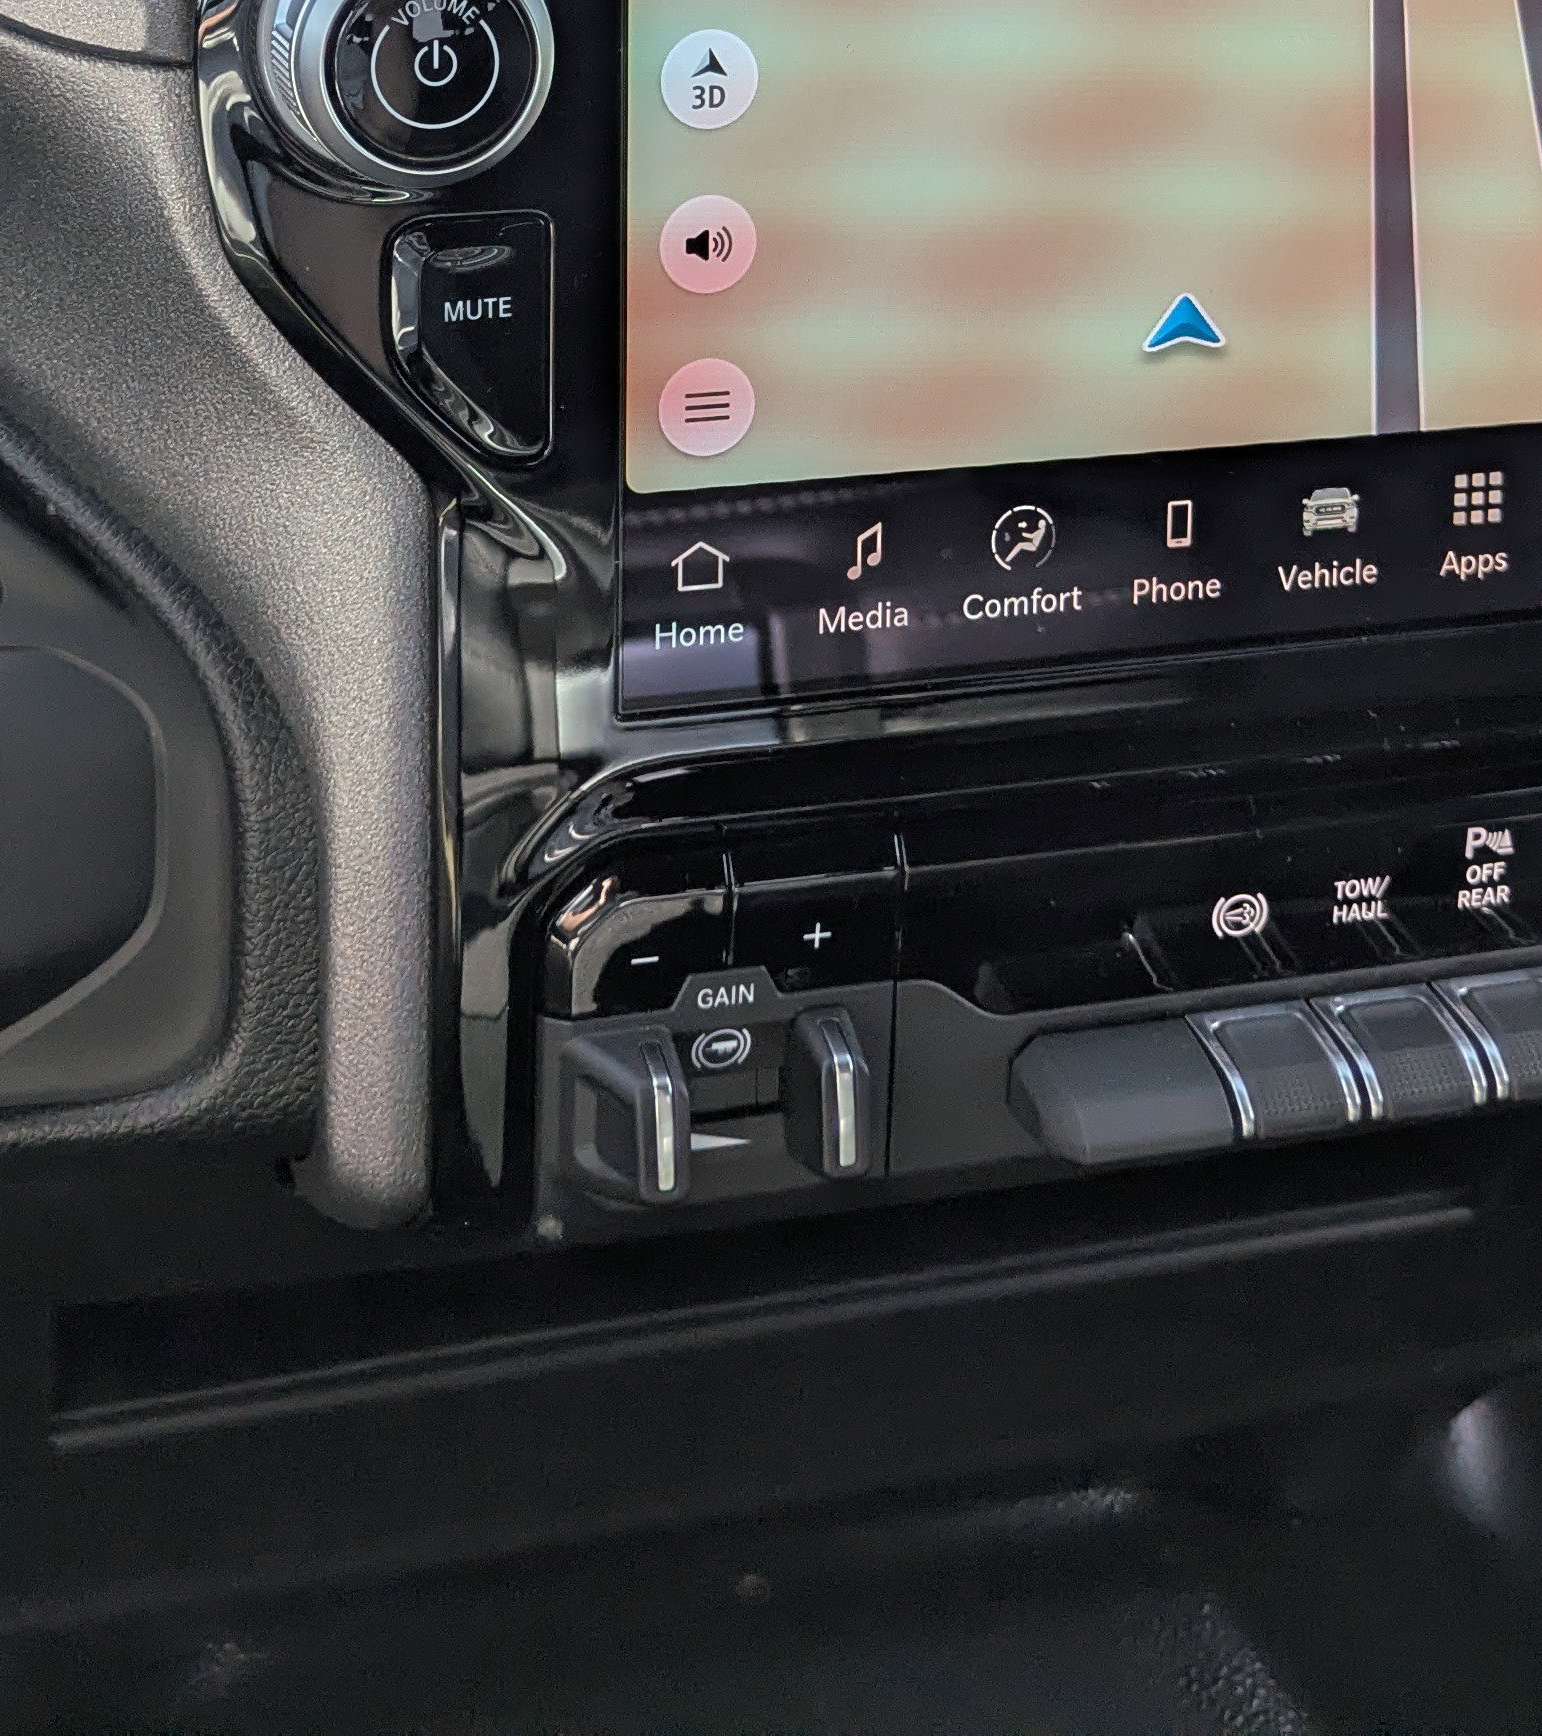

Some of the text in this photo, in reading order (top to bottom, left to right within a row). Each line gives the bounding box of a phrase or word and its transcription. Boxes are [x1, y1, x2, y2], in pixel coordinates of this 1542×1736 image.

[691, 85, 726, 110] 3D
[444, 296, 512, 323] MUTE
[654, 619, 745, 650] Home
[817, 600, 909, 635] Media
[962, 584, 1083, 622] Comfort
[1132, 574, 1222, 606] Phone
[1278, 559, 1378, 593] Vehicle
[1439, 547, 1509, 580] Apps
[1465, 862, 1507, 886] OFF
[1334, 875, 1392, 900] TOW/
[1458, 885, 1511, 910] REAR
[1332, 901, 1389, 925] HAUL
[696, 982, 755, 1010] GAIN
